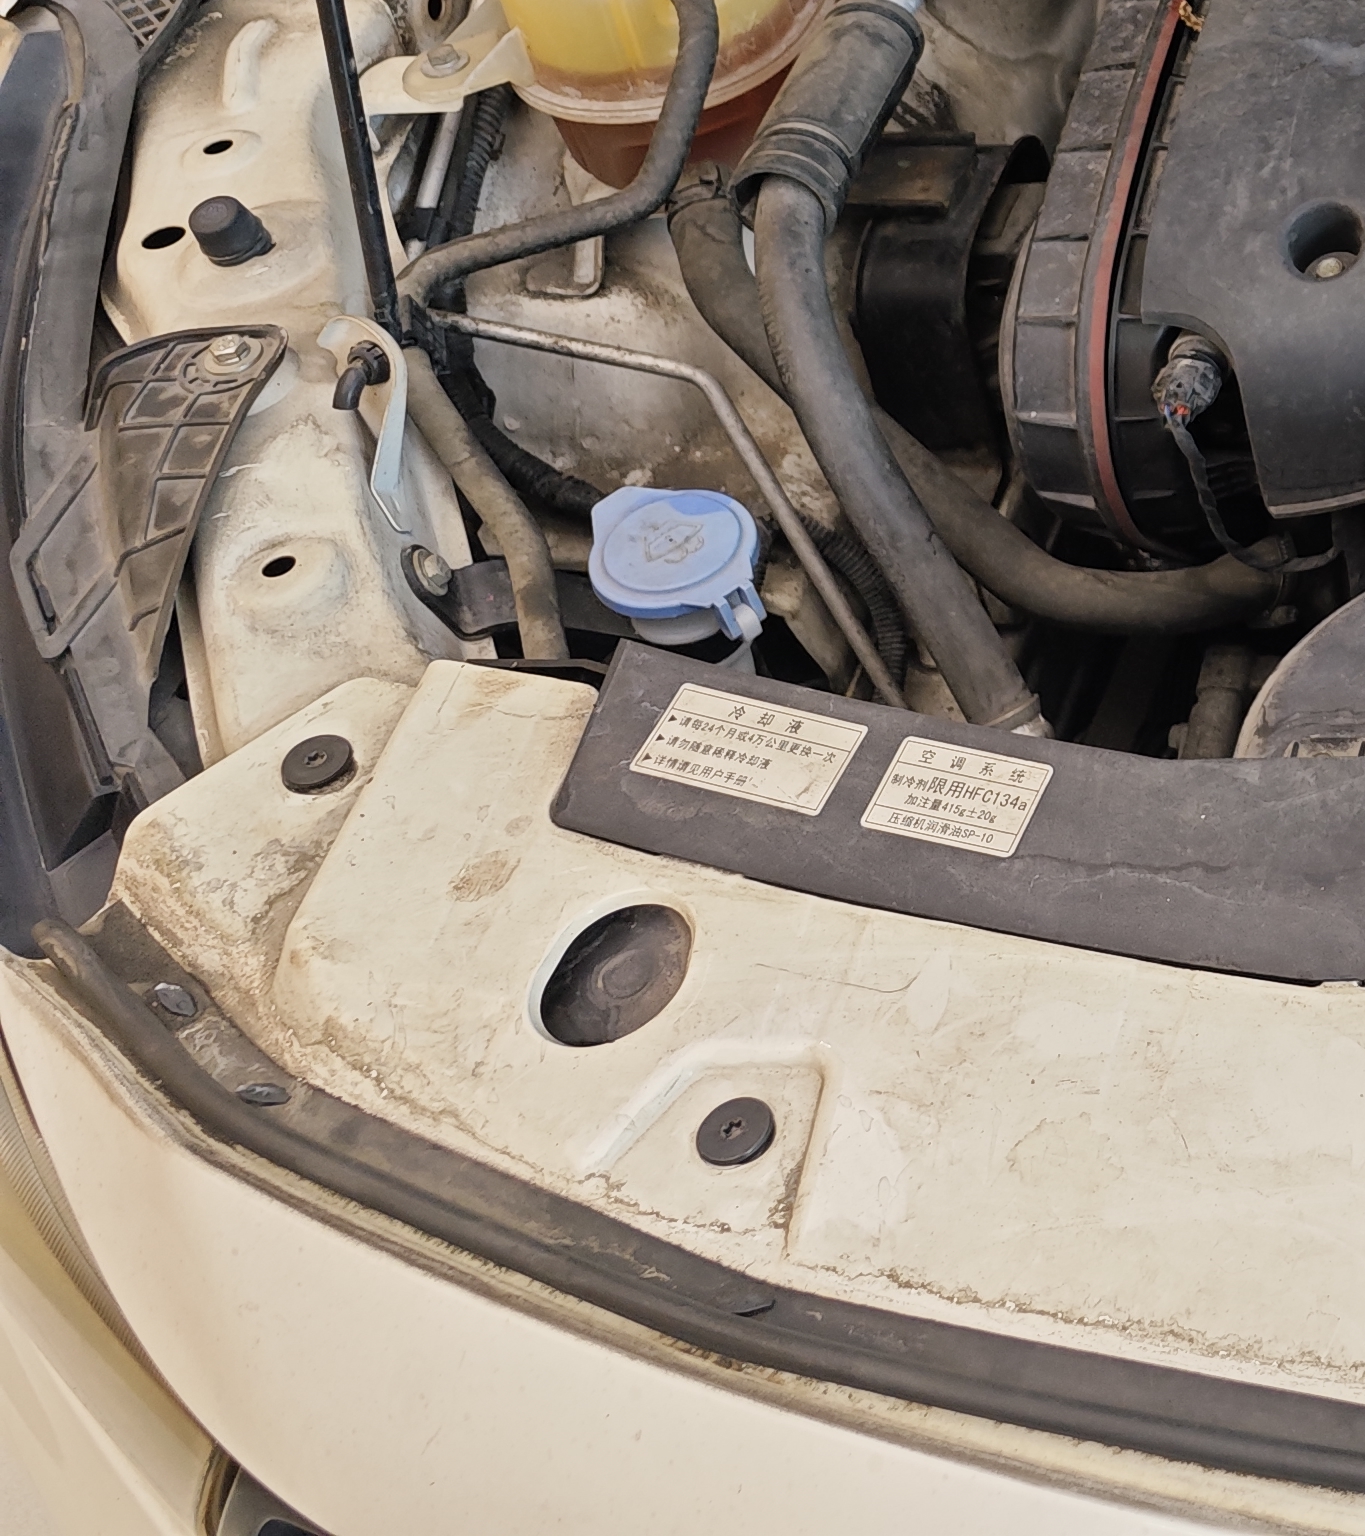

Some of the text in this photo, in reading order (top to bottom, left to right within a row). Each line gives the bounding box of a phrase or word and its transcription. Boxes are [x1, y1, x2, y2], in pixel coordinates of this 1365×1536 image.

[727, 705, 805, 735] 冷却液
[679, 715, 837, 764] 请每24个月或4万公里更换一次
[918, 749, 1028, 784] 空调系统
[890, 773, 1028, 812] 制冷剂限用HFC134a
[904, 793, 997, 824] 加注量415g±20g
[887, 812, 994, 844] 压缩机润滑油SP-10
